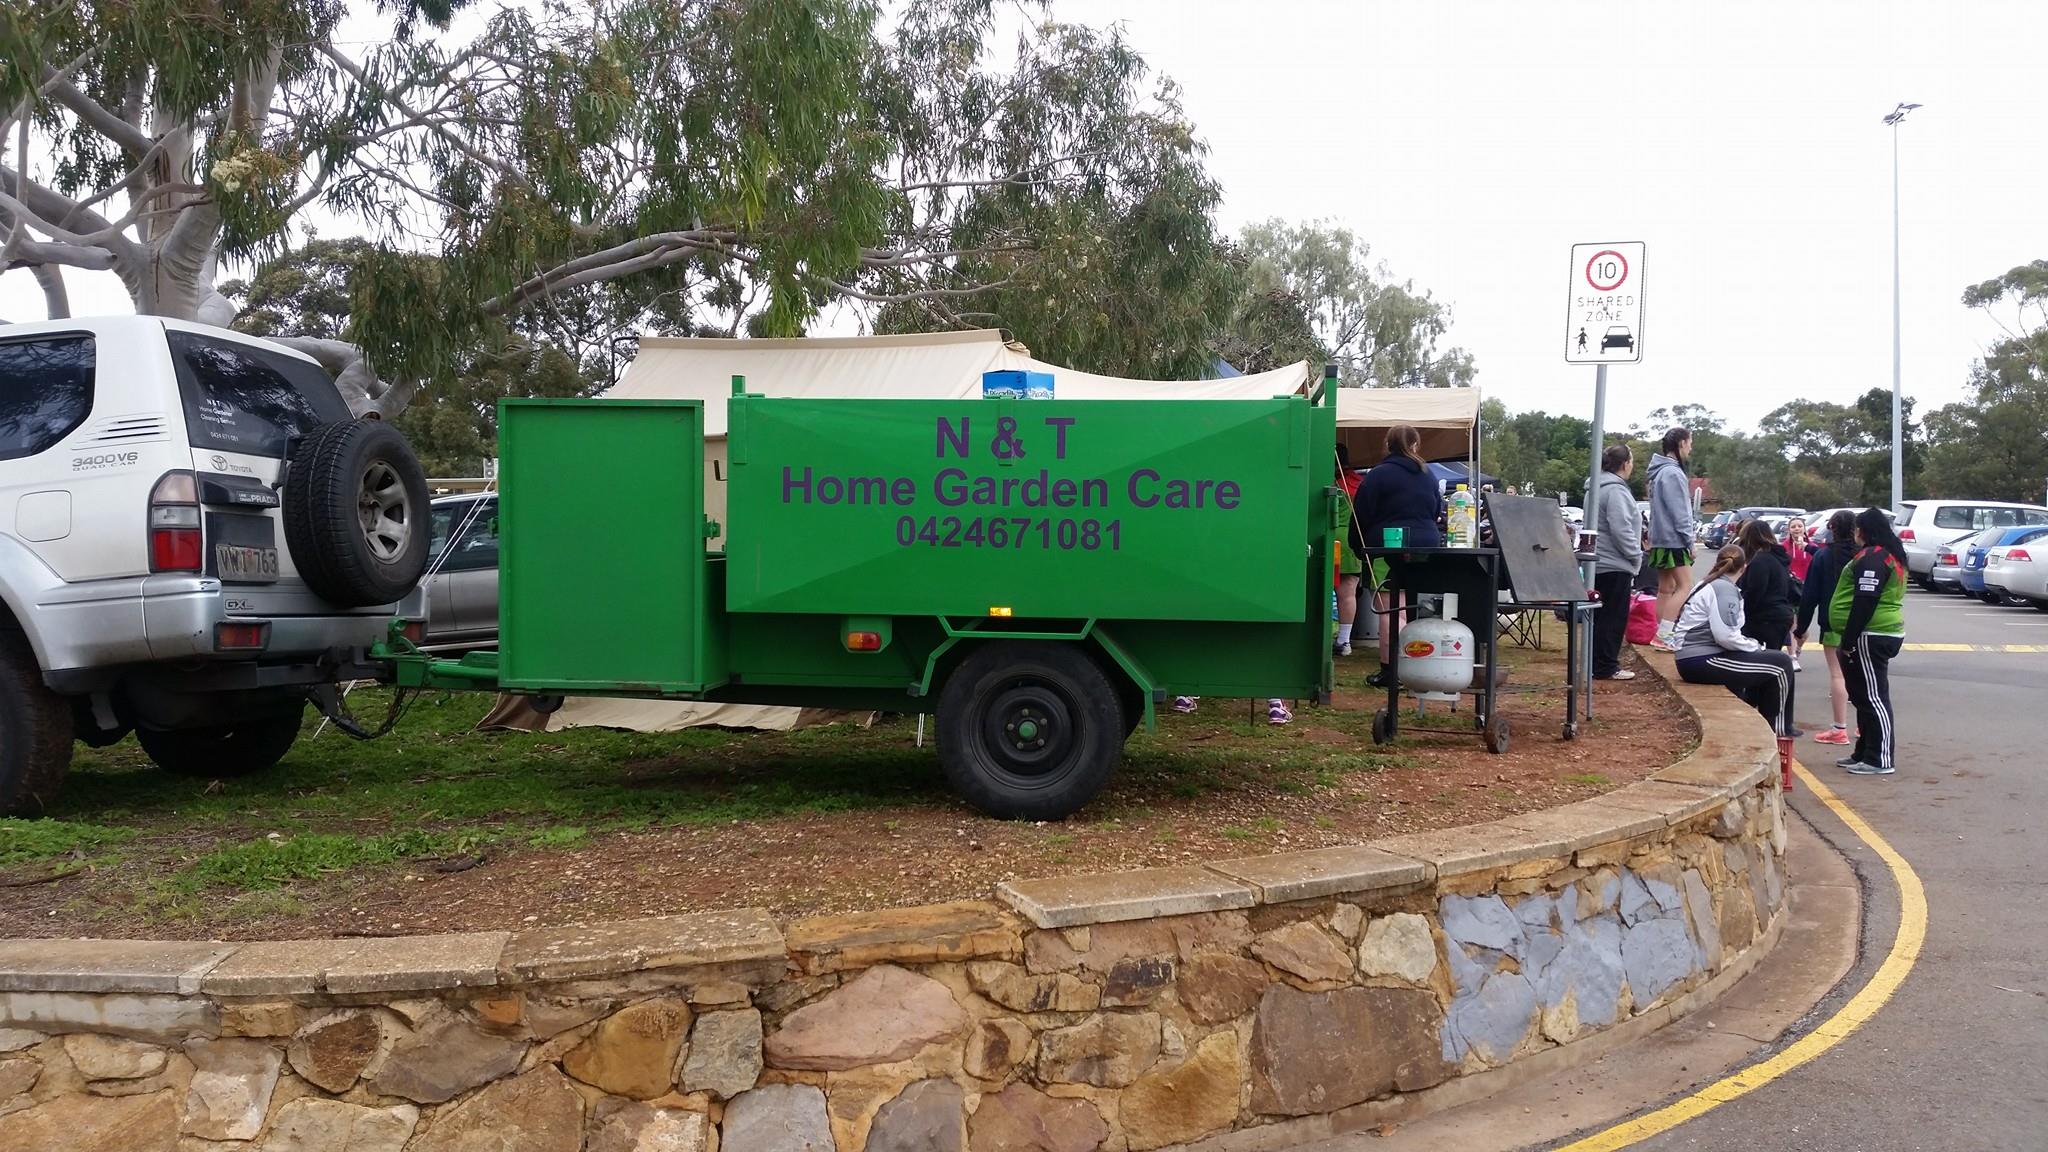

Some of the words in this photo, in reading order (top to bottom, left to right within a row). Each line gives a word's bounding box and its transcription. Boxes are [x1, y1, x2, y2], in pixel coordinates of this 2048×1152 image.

[1598, 262, 1617, 279] 10
[1577, 296, 1634, 307] SHARED
[1586, 311, 1624, 322] ZONE
[936, 417, 971, 458] N
[990, 417, 1026, 459] &
[1045, 417, 1076, 459] T
[72, 454, 116, 467] 3400
[117, 451, 139, 462] V6
[72, 464, 106, 472] QUAD
[229, 464, 253, 473] TOYOTA
[782, 466, 916, 505] Home
[933, 467, 1109, 508] Garden
[1127, 468, 1242, 510] Care
[250, 494, 277, 505] PRADO
[895, 515, 1122, 551] 0424671081
[253, 551, 277, 574] 763
[225, 599, 255, 611] GXL
